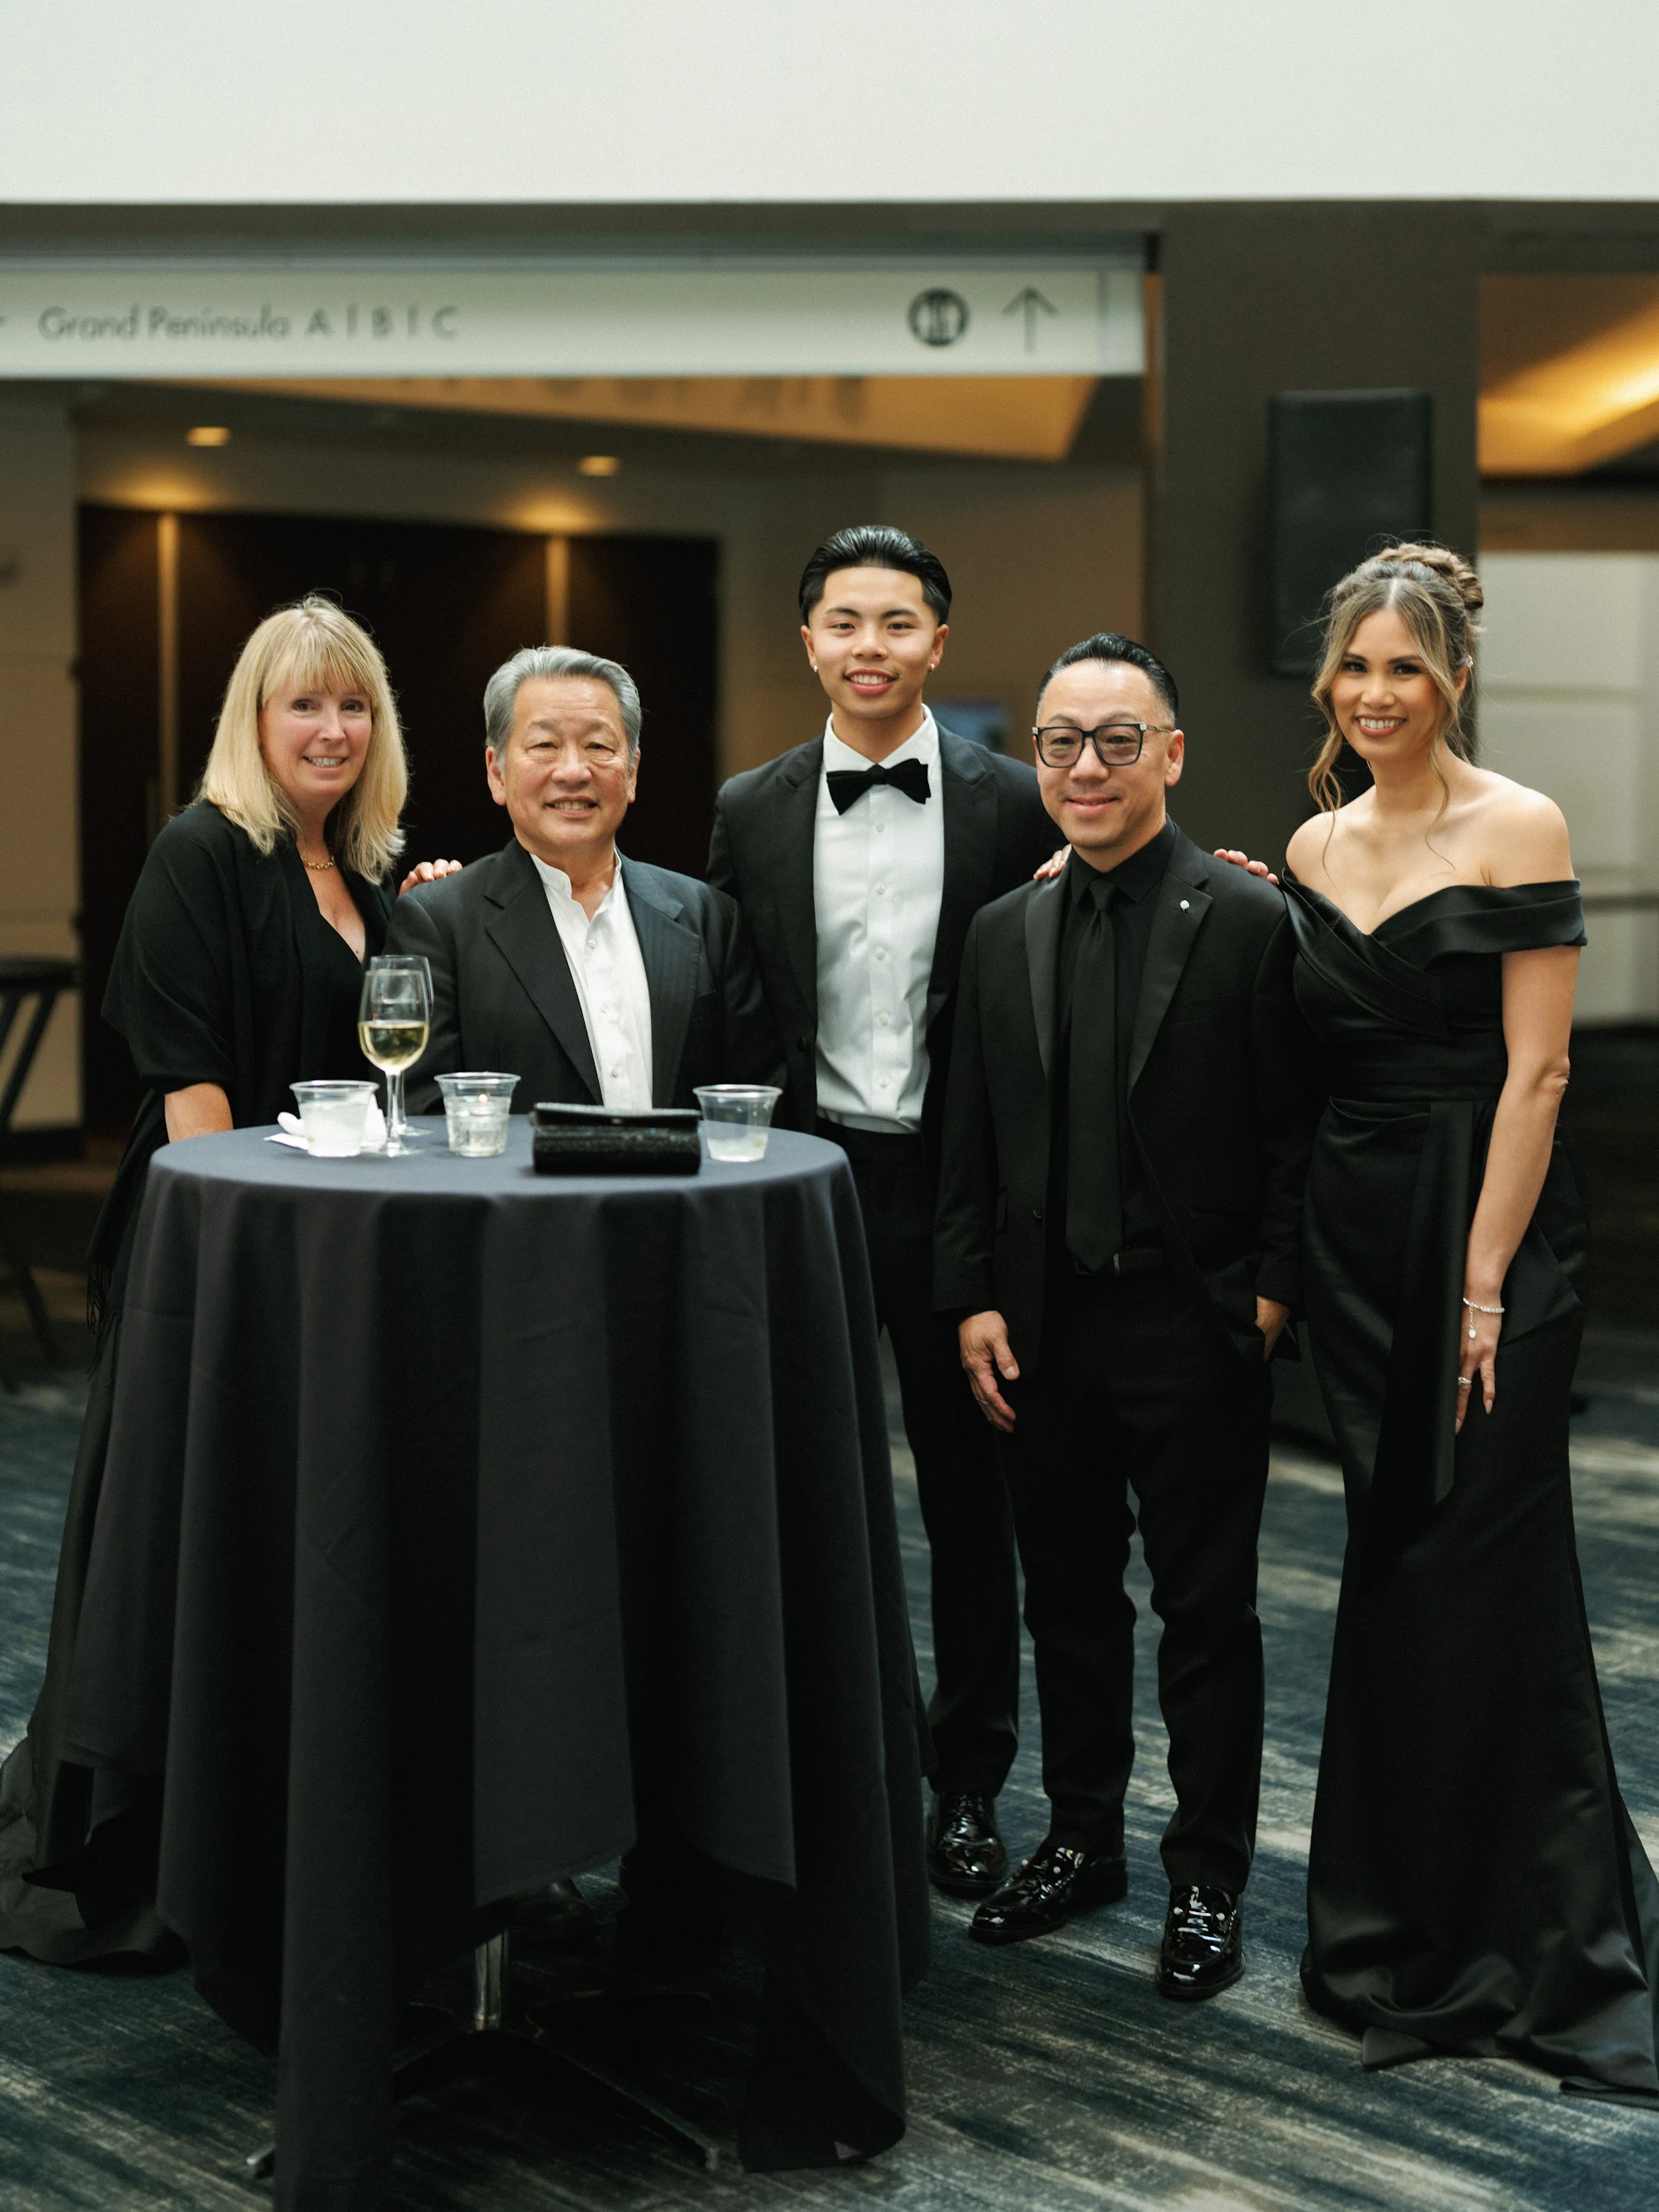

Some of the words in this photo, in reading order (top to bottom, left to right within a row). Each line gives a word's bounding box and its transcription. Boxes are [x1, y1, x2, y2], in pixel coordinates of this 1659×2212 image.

[38, 303, 140, 342] Grand
[147, 303, 291, 342] Peninsula
[305, 306, 334, 338] A
[371, 306, 395, 338] B
[431, 305, 461, 339] C
